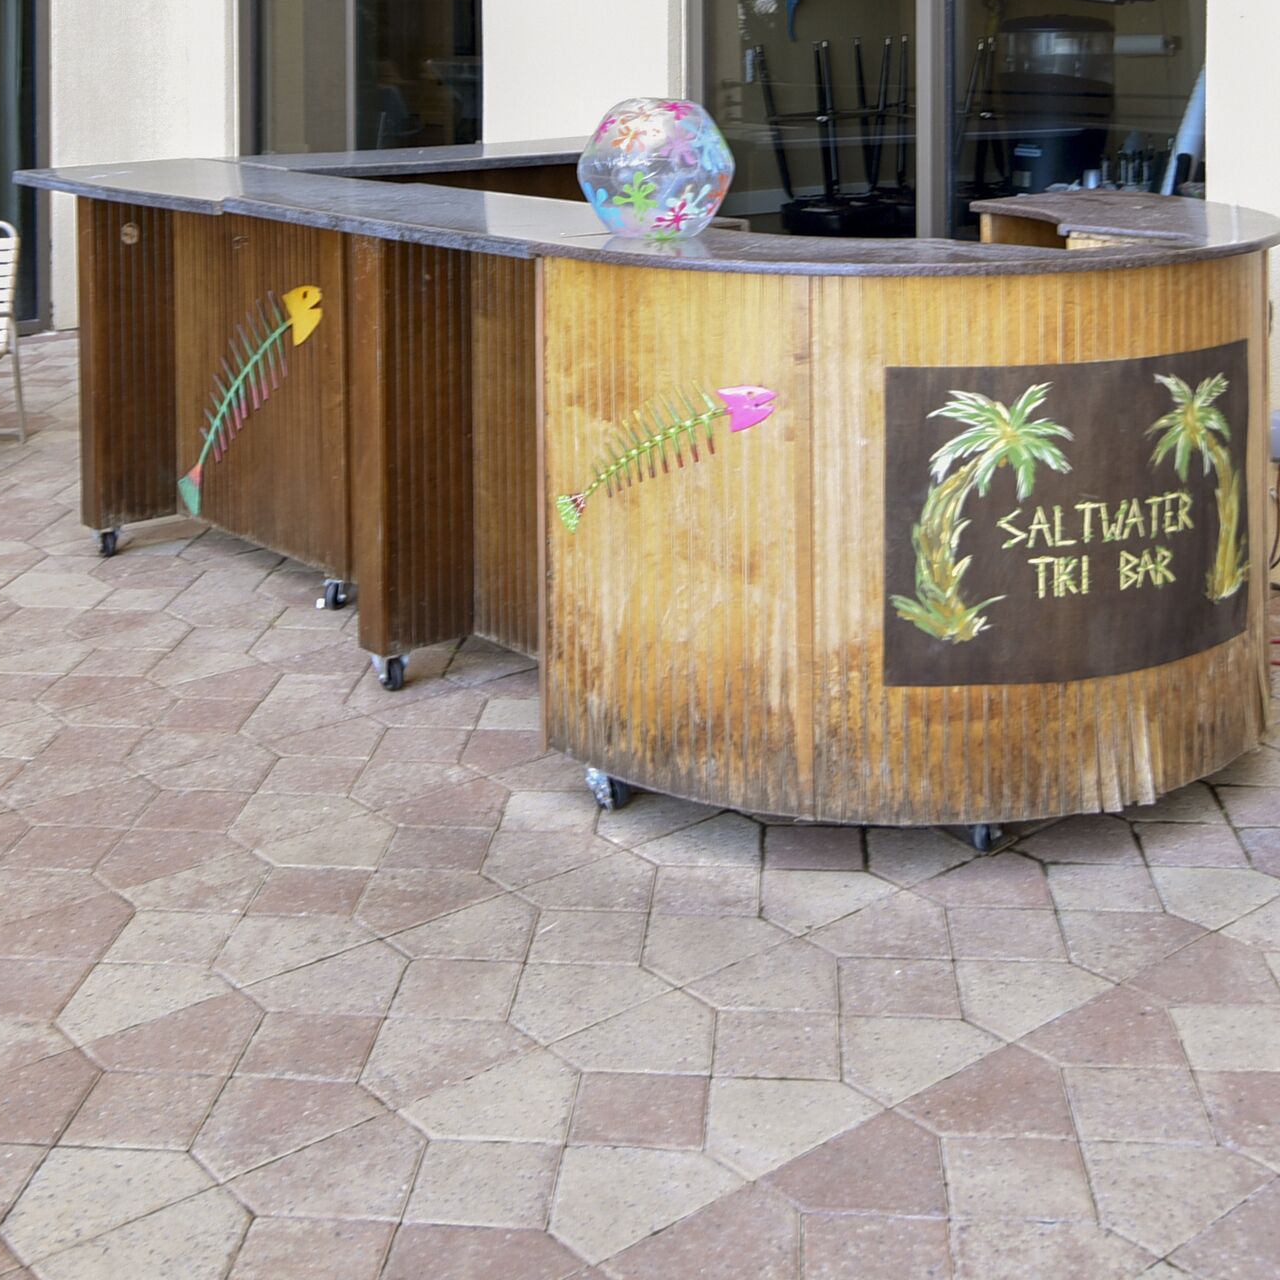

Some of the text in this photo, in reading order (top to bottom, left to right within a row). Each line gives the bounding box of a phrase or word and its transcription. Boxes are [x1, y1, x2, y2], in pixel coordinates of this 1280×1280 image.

[996, 490, 1195, 549] SALTWATER
[1027, 545, 1177, 599] TIKI BAR
